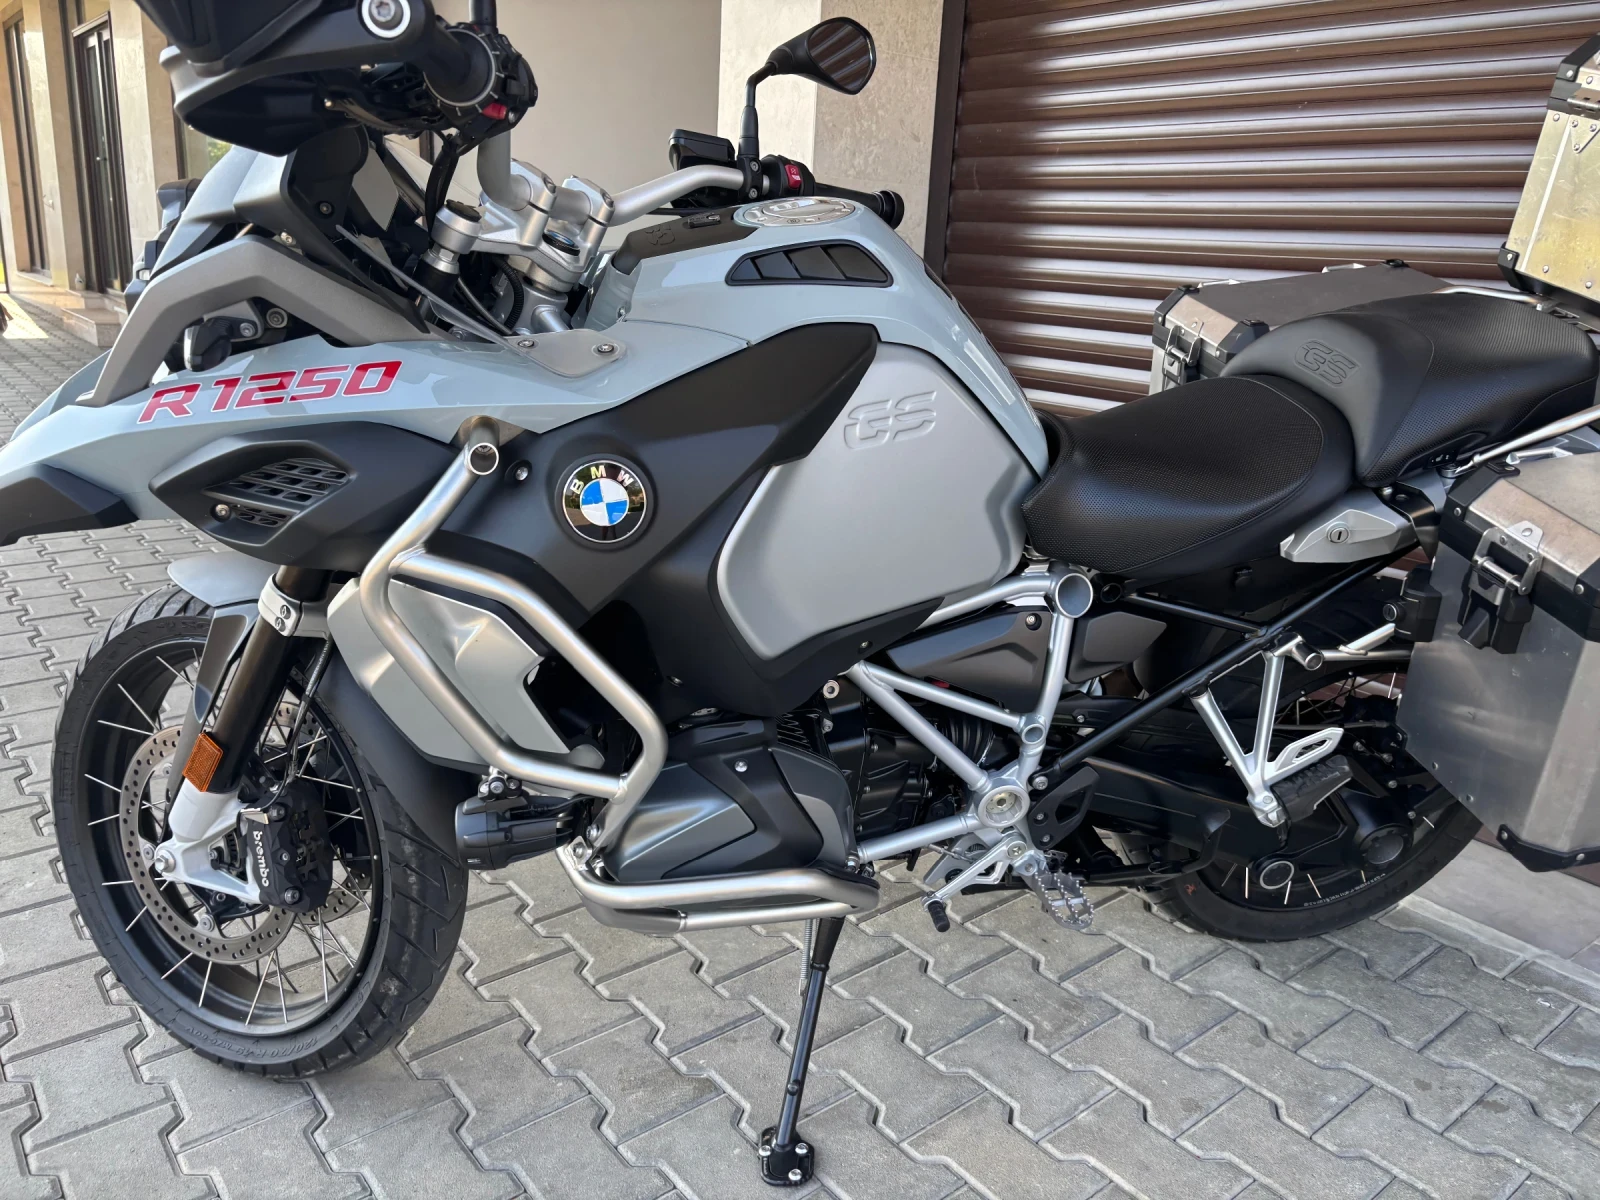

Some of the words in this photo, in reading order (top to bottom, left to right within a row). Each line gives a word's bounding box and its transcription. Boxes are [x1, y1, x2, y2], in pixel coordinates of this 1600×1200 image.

[1296, 340, 1358, 385] GS
[137, 383, 201, 424] R
[210, 360, 402, 412] 1250
[844, 390, 937, 450] GS
[570, 465, 634, 495] BMW
[253, 831, 269, 887] brembo
